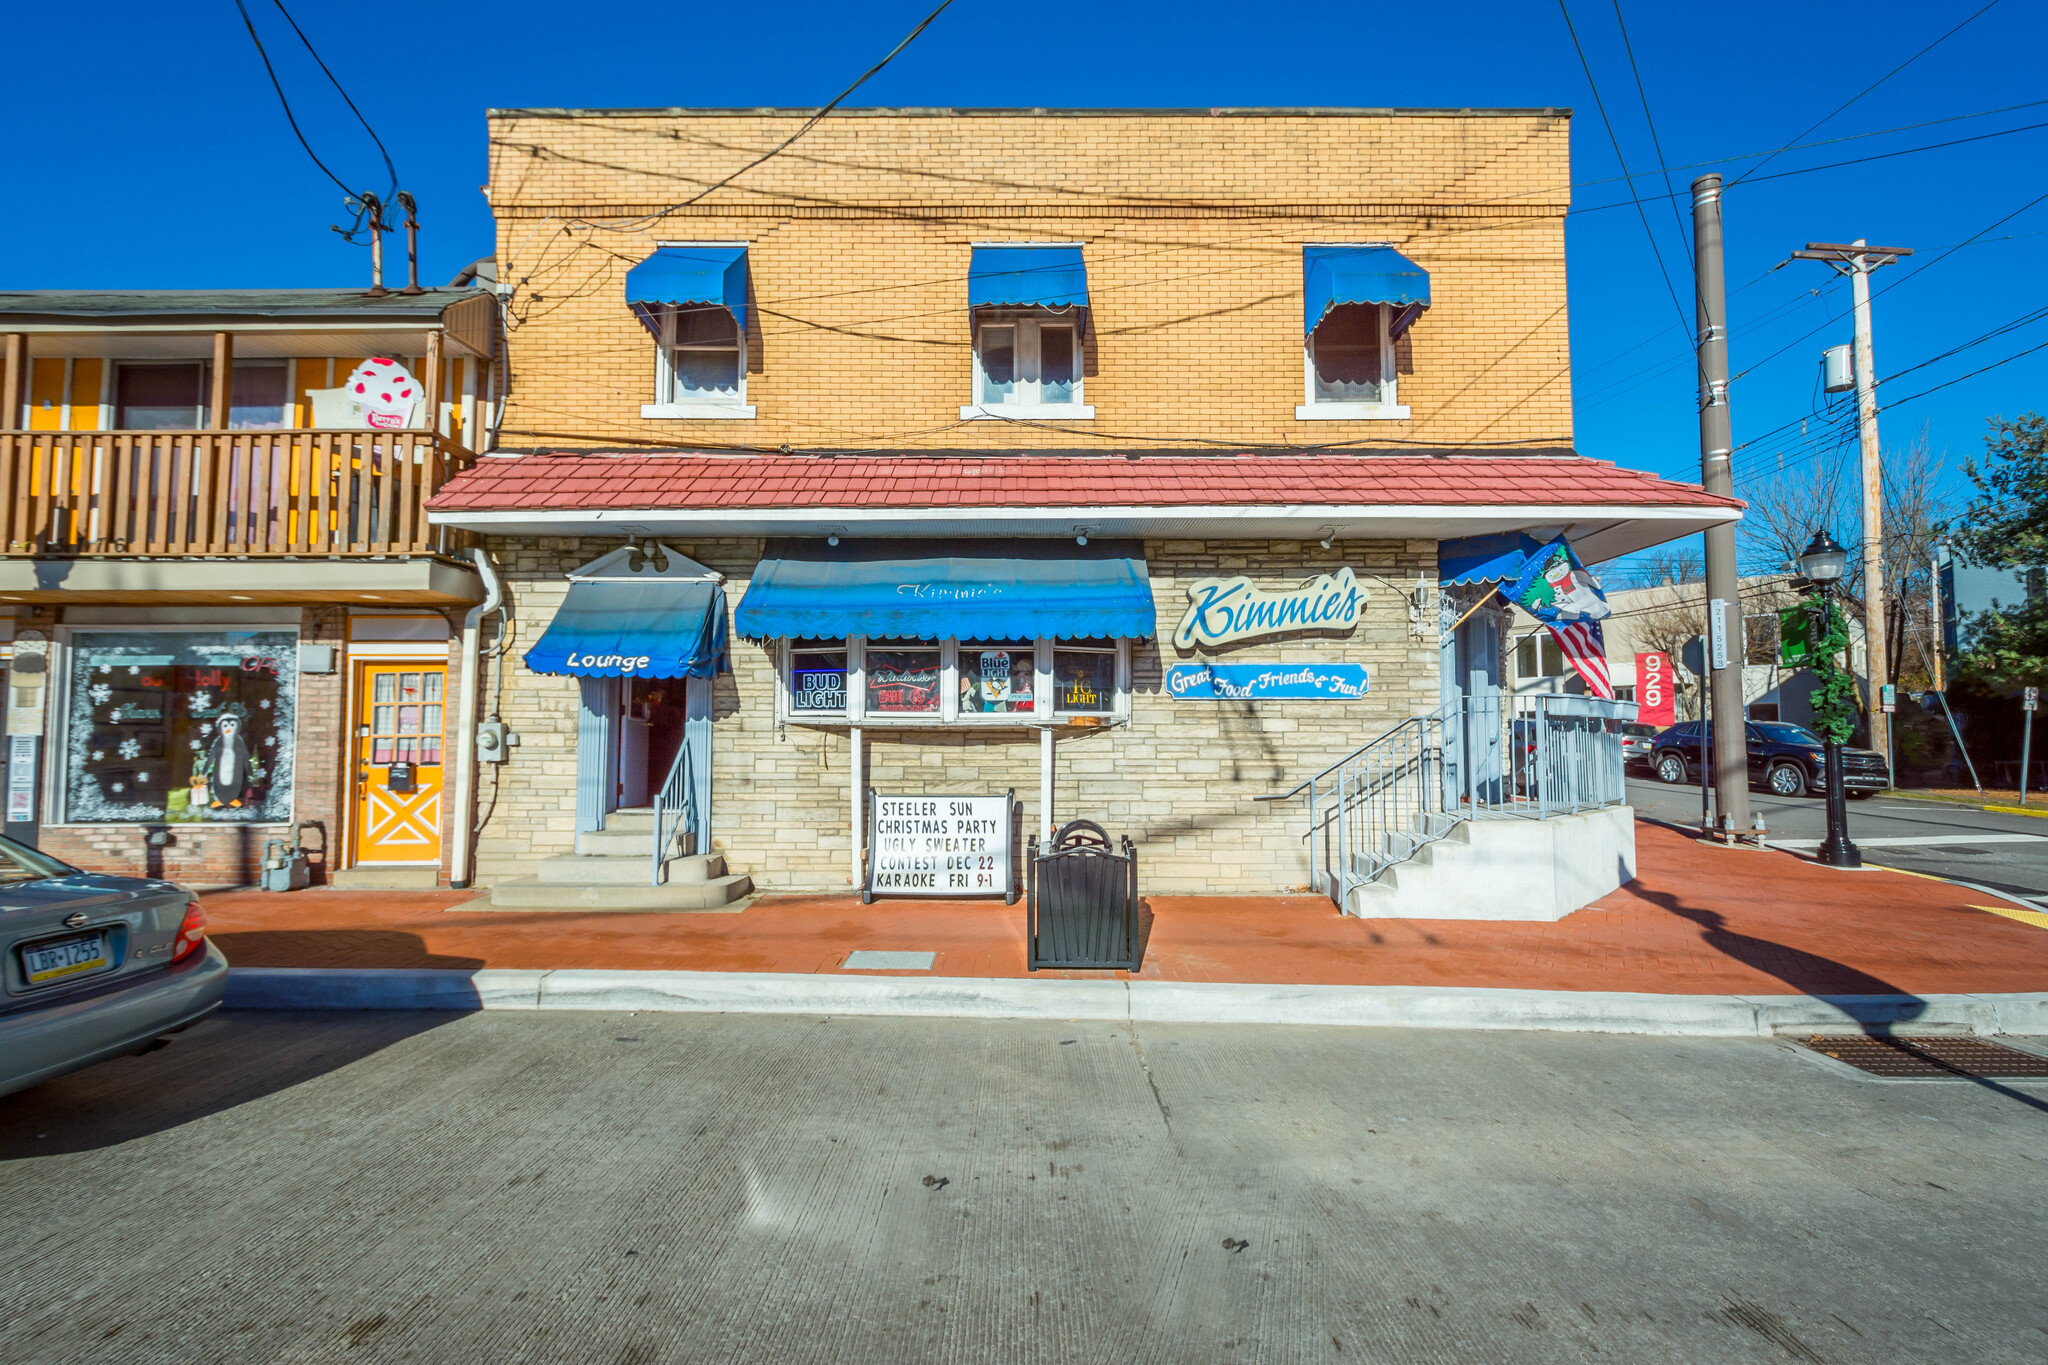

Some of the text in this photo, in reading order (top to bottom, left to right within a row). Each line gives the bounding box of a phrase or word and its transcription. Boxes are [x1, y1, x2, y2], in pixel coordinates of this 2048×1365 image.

[1184, 576, 1364, 639] Kimmie's
[566, 652, 651, 672] Lounge
[981, 657, 1010, 668] Blue
[981, 669, 1010, 677] LIGHT
[802, 673, 842, 691] BUD
[1170, 665, 1367, 698] Great Food Friends & Fun!
[1645, 655, 1661, 707] 929
[796, 691, 848, 709] LIGHT
[878, 690, 906, 704] BUD
[1066, 693, 1097, 704] LIGHT
[882, 802, 973, 816] STEELER SUN
[877, 820, 997, 834] CHRISTMAS PARTY
[884, 838, 986, 852] UGLY SWEATER
[880, 856, 994, 870] CONTEST DEC 22
[876, 873, 993, 887] KARAOKE FRI 9-1
